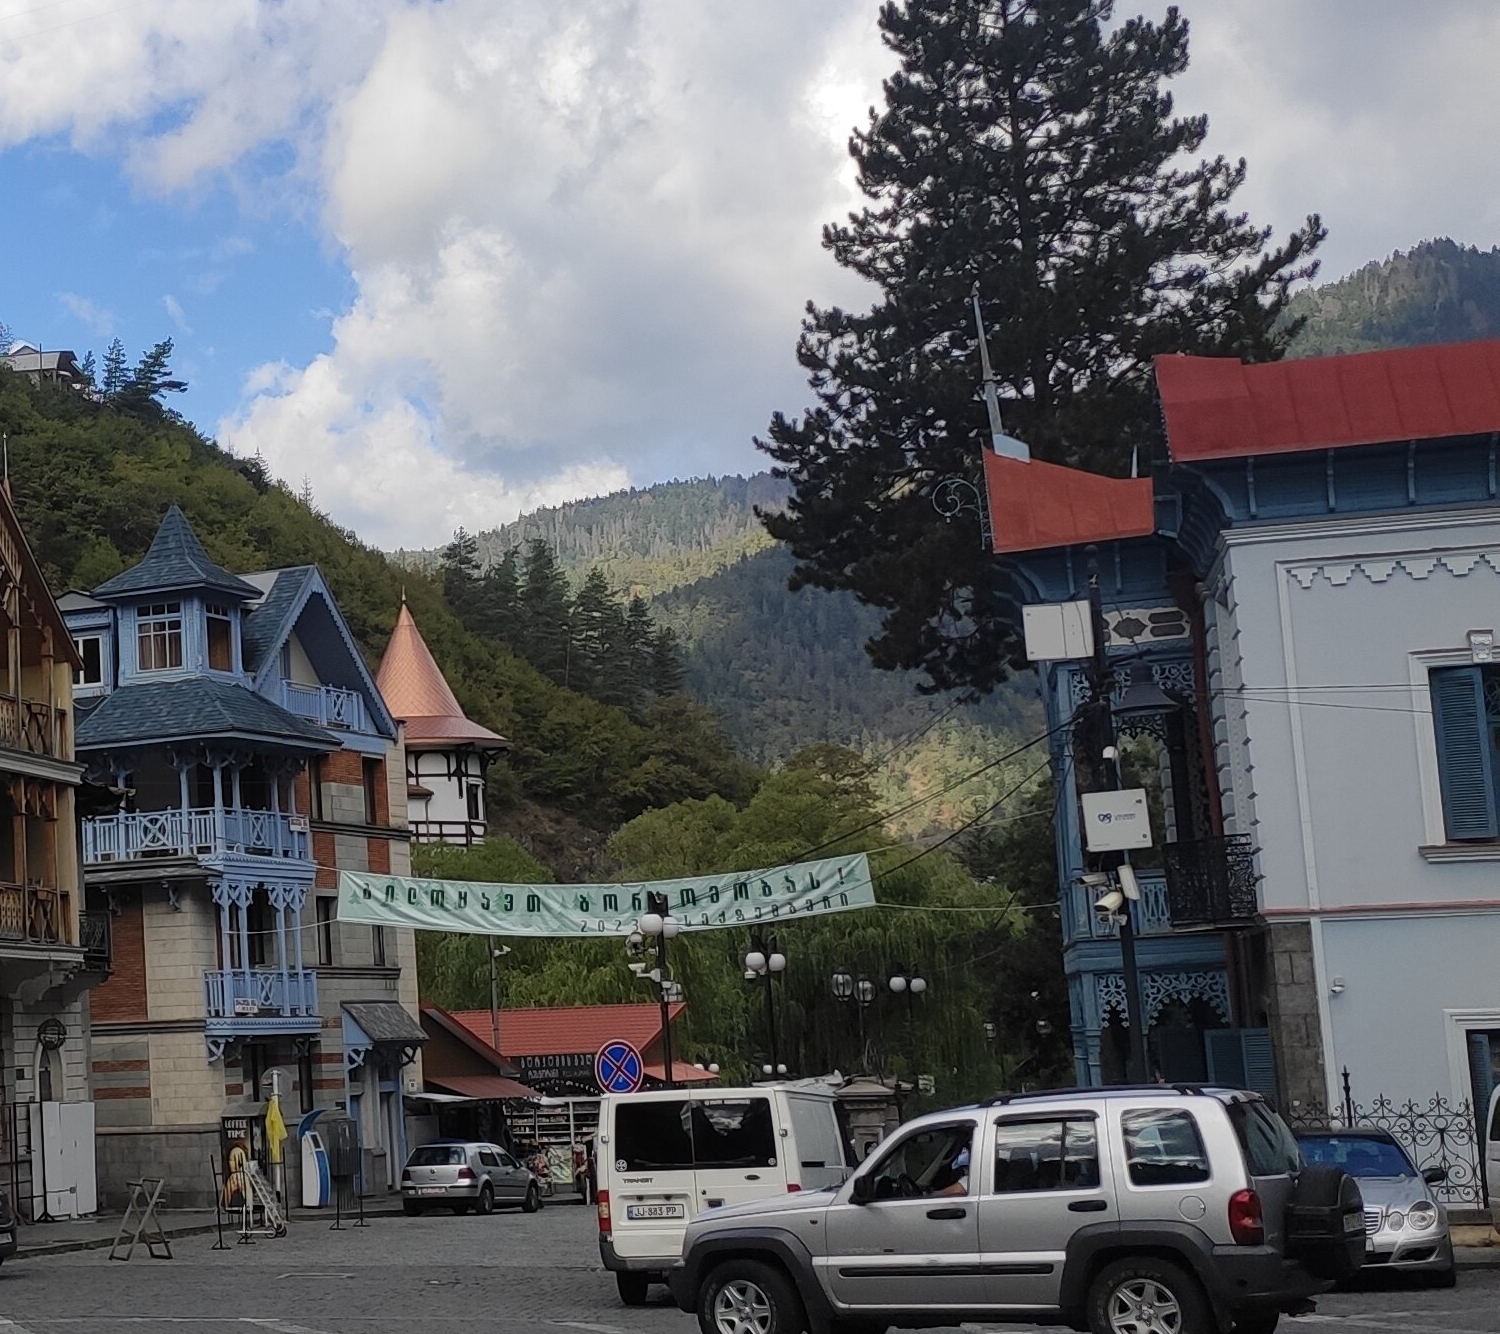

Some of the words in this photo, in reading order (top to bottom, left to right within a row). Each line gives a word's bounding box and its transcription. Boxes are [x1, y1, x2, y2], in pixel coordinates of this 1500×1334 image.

[362, 882, 541, 913] გილოცავთ
[579, 871, 821, 913] ბორომობას
[581, 918, 639, 933] 2023
[683, 892, 849, 927] სექტემბერი
[226, 1129, 246, 1139] TIME
